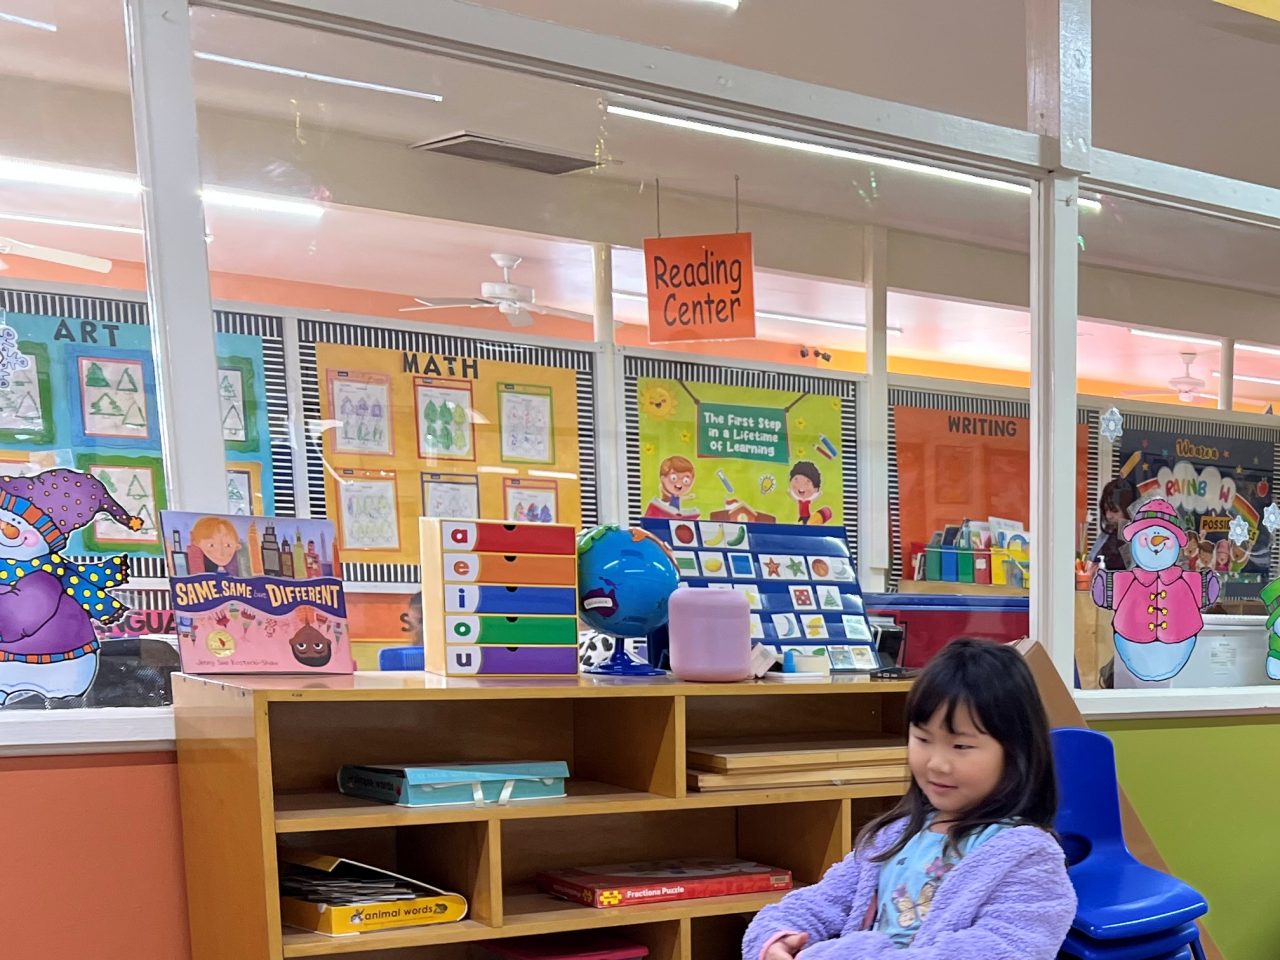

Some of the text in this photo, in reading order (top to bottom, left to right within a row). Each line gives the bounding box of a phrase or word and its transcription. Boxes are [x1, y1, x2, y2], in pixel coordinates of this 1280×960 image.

[654, 250, 741, 294] Reading
[664, 293, 741, 326] Center
[54, 319, 119, 347] ART
[403, 352, 479, 379] MATH
[704, 412, 781, 432] The First Step
[948, 416, 1017, 437] WRITING
[708, 428, 778, 442] in a Lifetime
[710, 441, 775, 457] of Learning
[451, 529, 468, 544] a
[454, 561, 469, 576] e
[223, 581, 252, 599] SAME
[265, 584, 340, 608] DIFFERENT
[458, 588, 466, 608] i
[454, 622, 472, 637] o
[456, 653, 472, 667] u
[627, 889, 661, 898] Fractions
[662, 886, 684, 895] Puzzle
[365, 905, 433, 920] animal words
